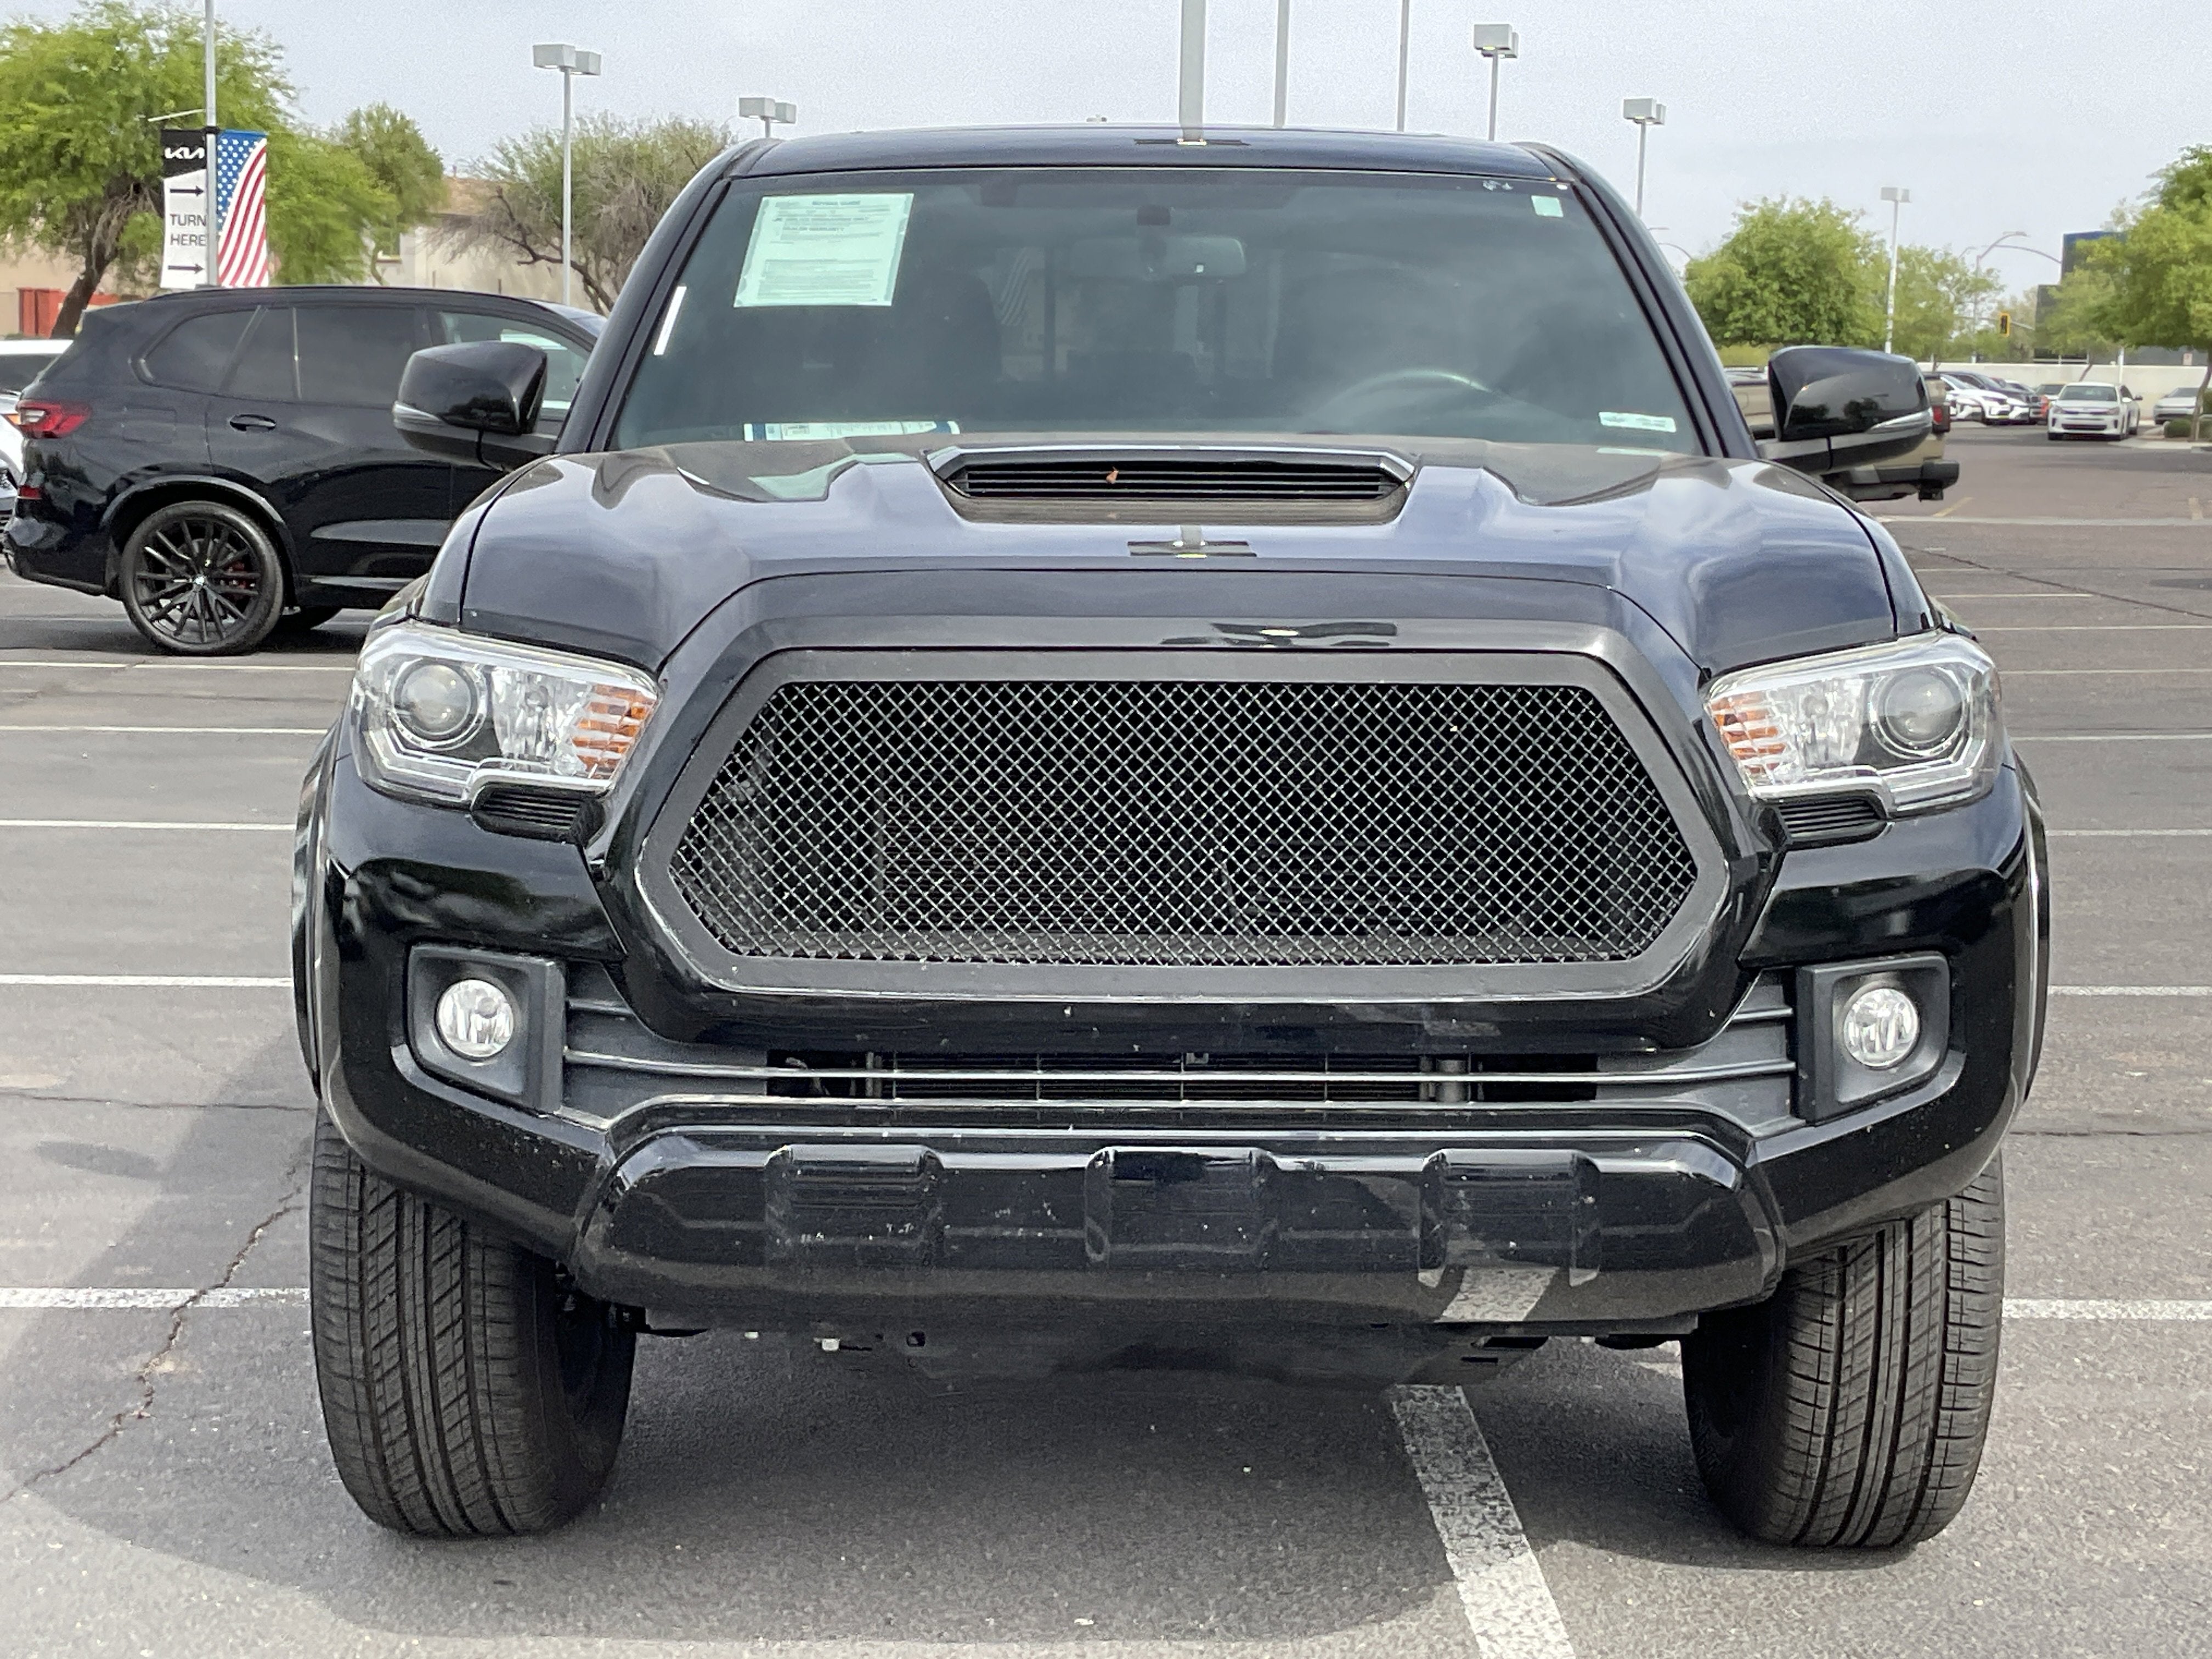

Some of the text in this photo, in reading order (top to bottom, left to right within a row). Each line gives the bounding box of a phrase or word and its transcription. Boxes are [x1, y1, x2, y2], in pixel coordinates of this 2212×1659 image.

[165, 147, 205, 159] KIA
[170, 213, 207, 226] TURN
[170, 234, 207, 246] HERE
